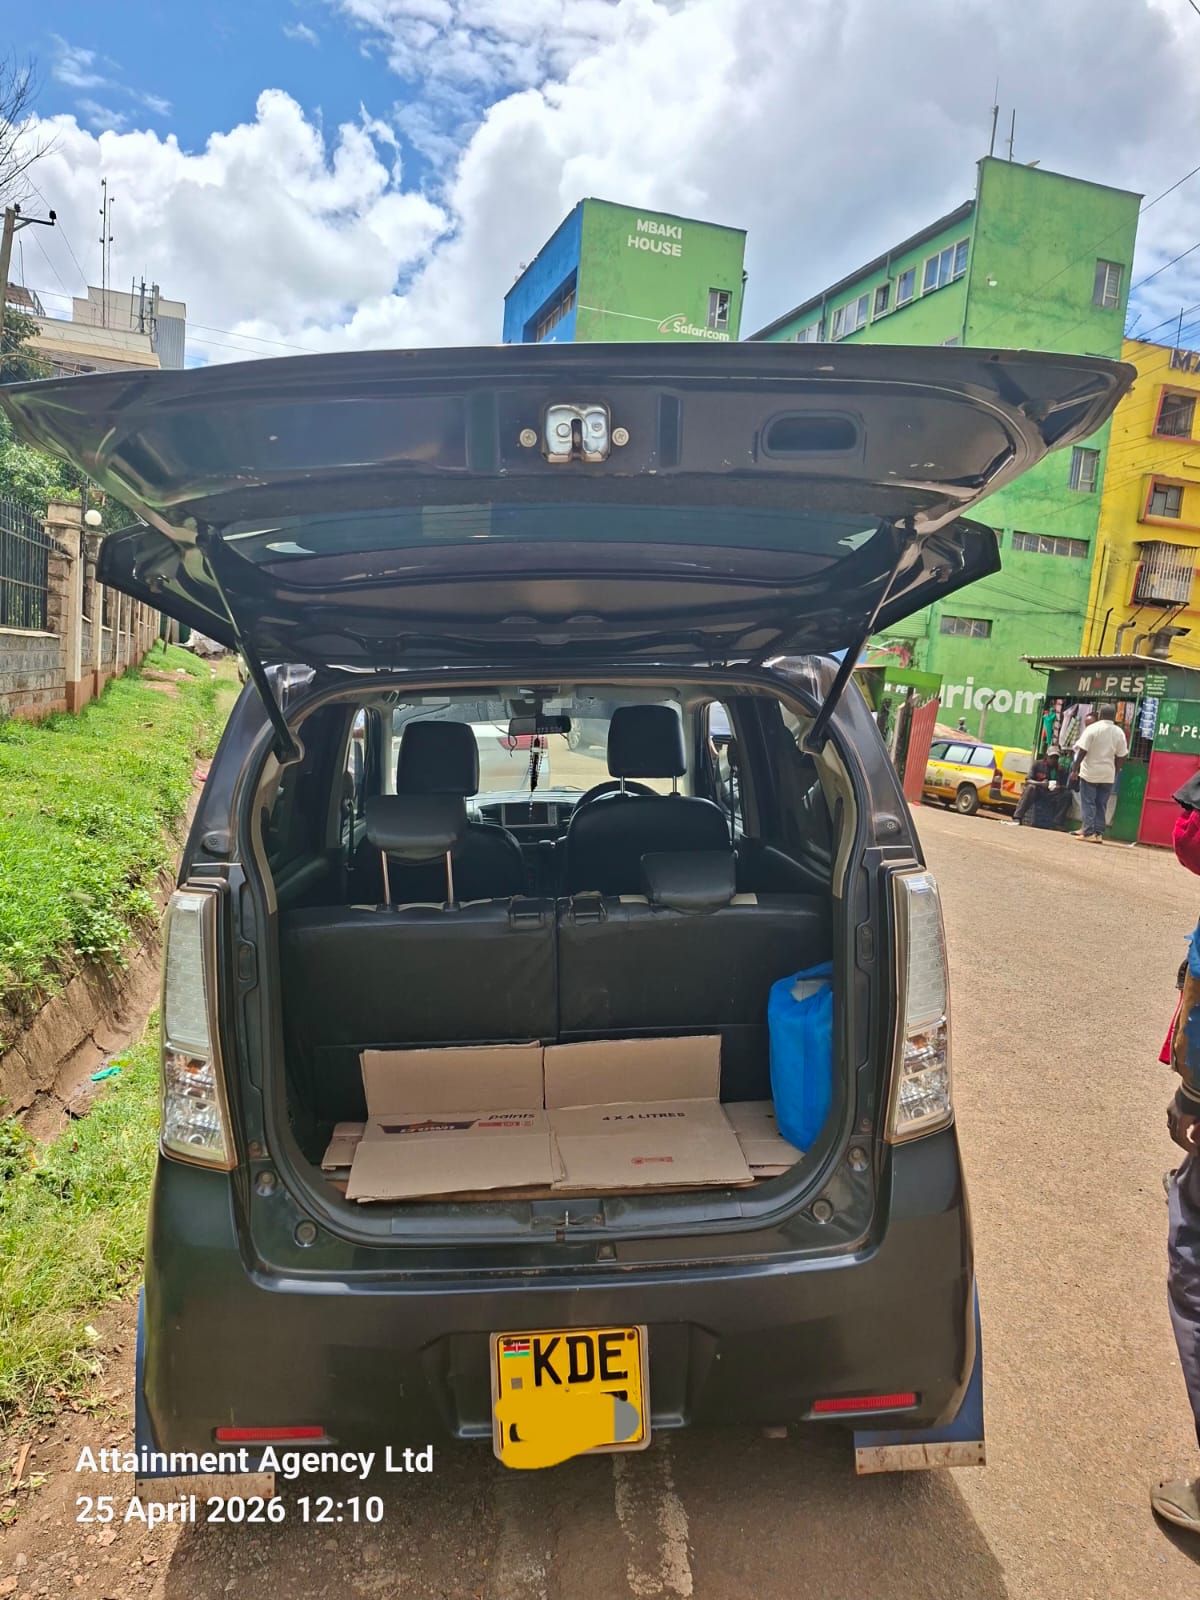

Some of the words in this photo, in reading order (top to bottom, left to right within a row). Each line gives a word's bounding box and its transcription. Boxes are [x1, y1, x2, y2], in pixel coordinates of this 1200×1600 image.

[636, 218, 682, 240] MBAKI
[627, 234, 682, 257] HOUSE
[673, 320, 730, 342] Safaricom
[532, 1332, 628, 1387] KDE
